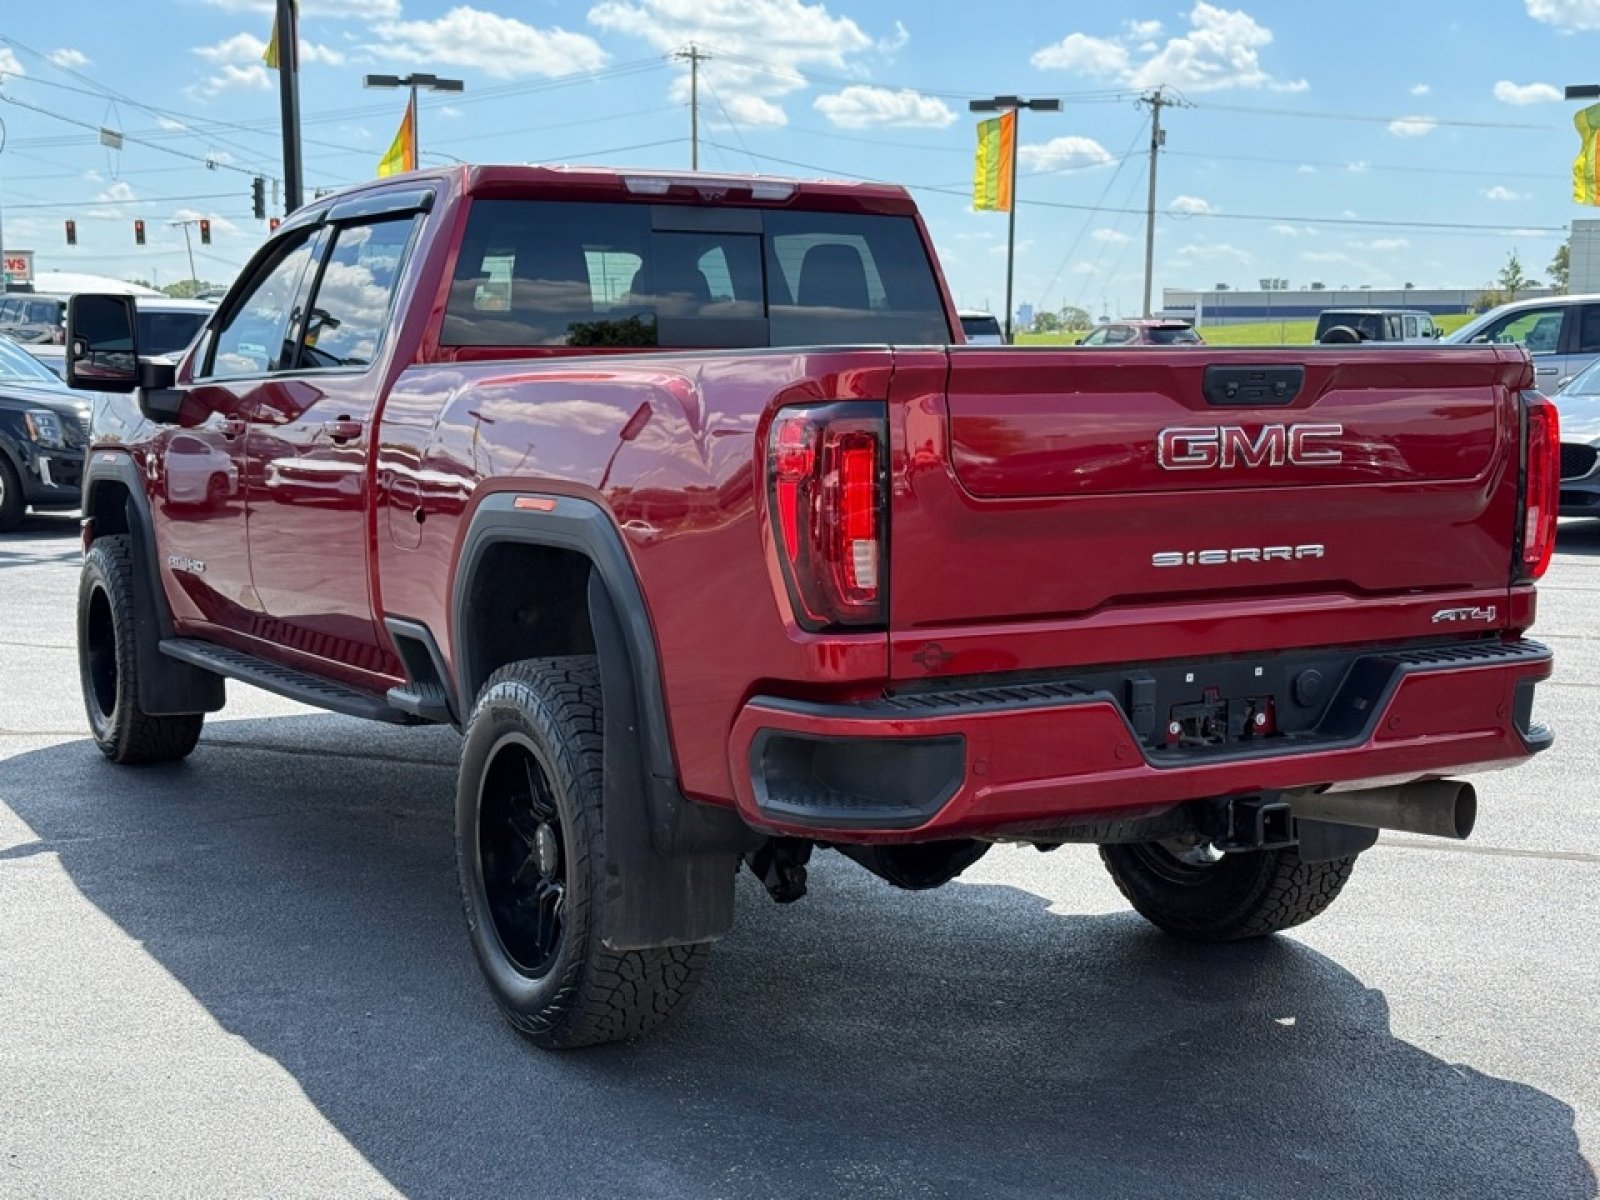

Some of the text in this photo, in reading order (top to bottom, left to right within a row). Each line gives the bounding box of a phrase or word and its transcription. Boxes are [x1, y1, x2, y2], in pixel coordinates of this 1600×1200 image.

[1158, 424, 1343, 470] GMC
[1151, 544, 1325, 567] SIERRA
[1431, 605, 1496, 623] AT4
